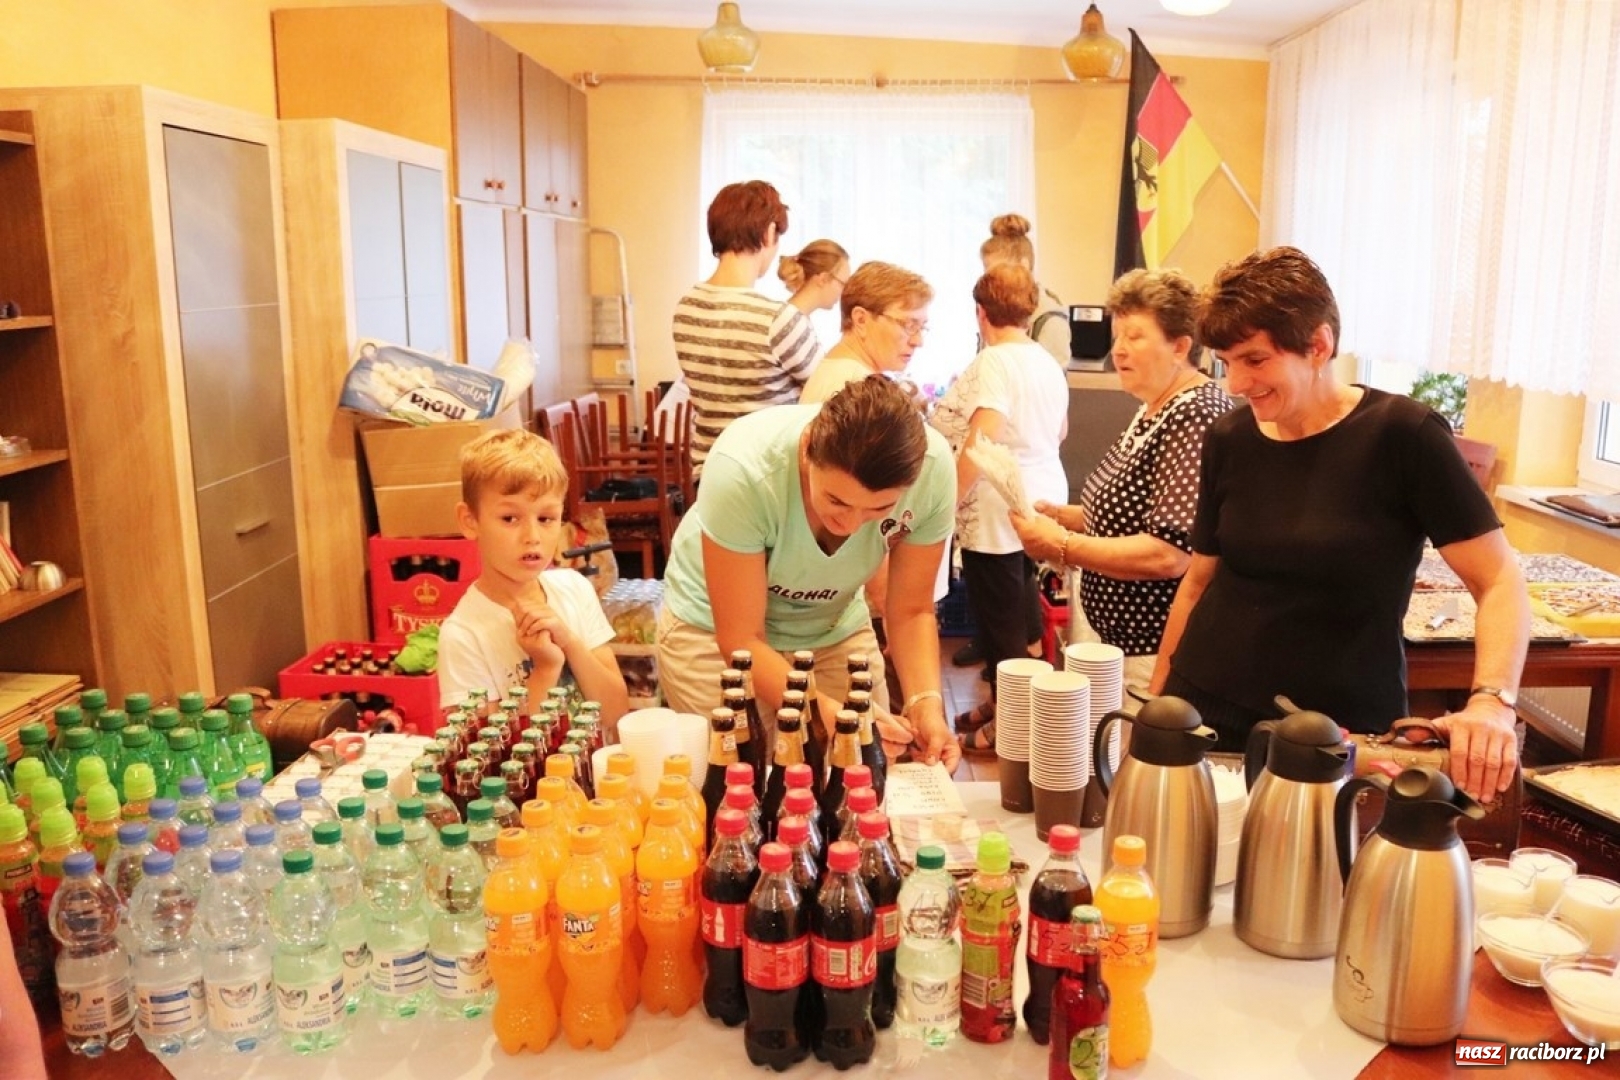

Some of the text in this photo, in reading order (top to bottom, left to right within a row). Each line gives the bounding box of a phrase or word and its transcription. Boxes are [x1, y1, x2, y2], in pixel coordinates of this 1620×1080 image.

[409, 393, 467, 420] mola
[768, 584, 839, 600] ALOHA!
[563, 917, 594, 933] FANTA
